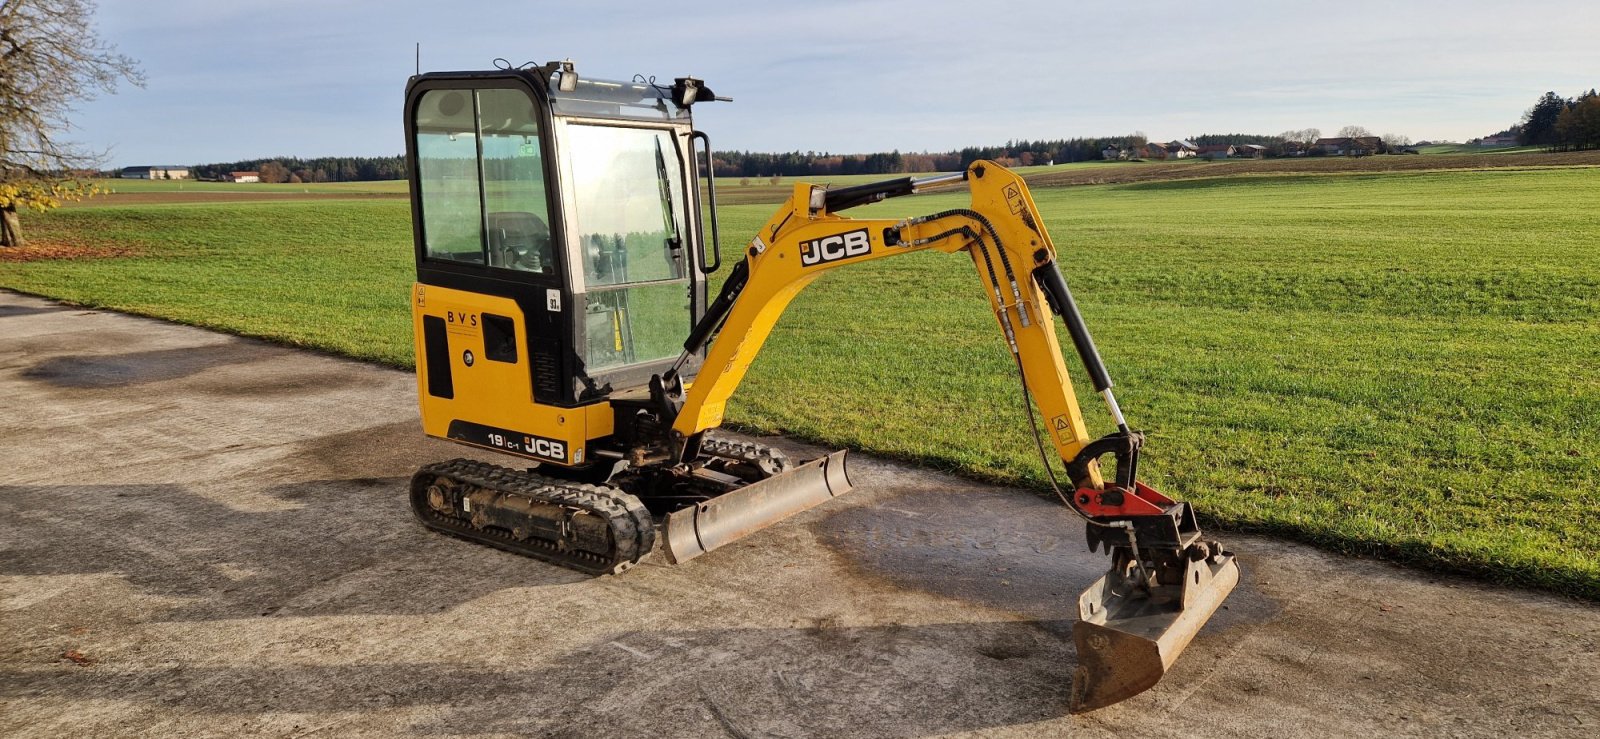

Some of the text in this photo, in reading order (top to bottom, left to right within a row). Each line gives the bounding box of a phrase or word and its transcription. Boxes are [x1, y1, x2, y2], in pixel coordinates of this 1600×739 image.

[803, 231, 870, 265] JCB
[488, 433, 503, 447] 19
[525, 438, 565, 460] JCB
